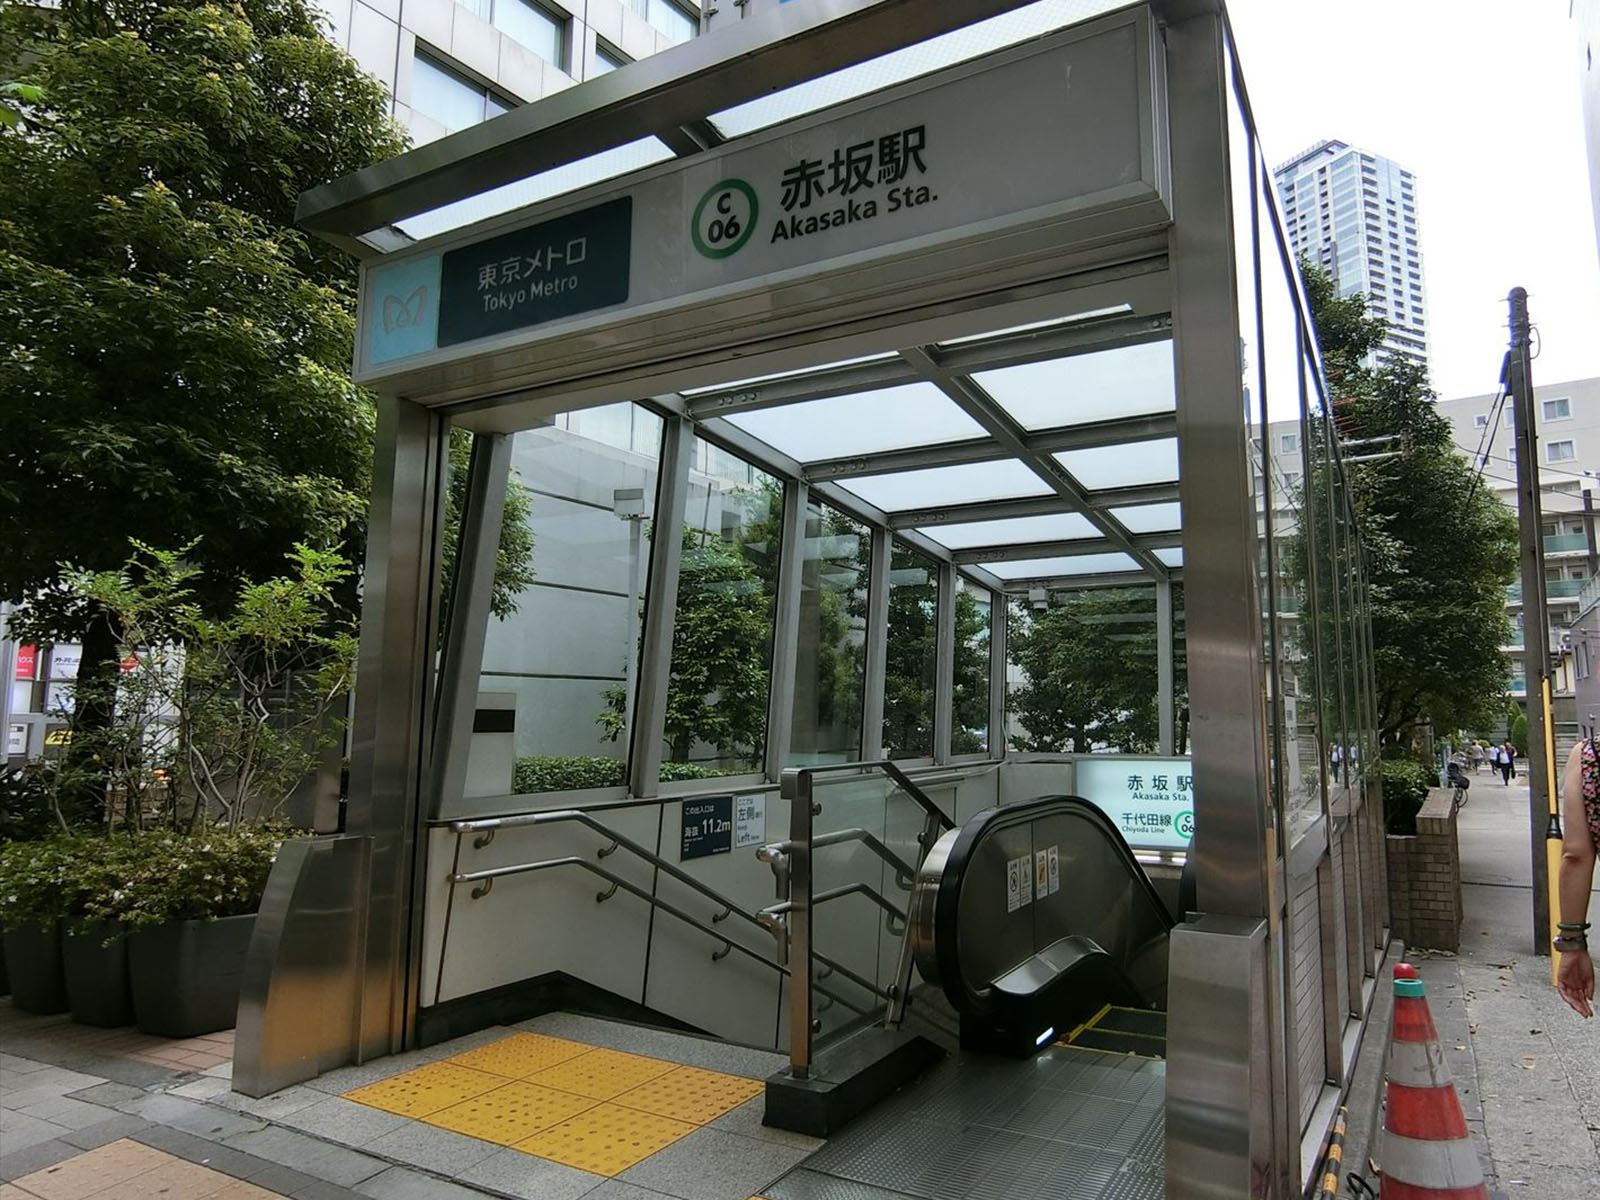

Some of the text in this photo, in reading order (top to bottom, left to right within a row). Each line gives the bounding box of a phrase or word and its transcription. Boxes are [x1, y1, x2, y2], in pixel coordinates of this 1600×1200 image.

[780, 125, 927, 212] 赤坂駅
[717, 192, 732, 214] C
[771, 185, 938, 244] Akasaka Sta.
[707, 215, 741, 243] 06
[477, 237, 587, 291] 東京メトロ
[483, 275, 579, 312] Tokyo Metro
[1127, 775, 1194, 792] 赤坂駅
[1132, 792, 1190, 801] Akasaka Sta.
[703, 819, 731, 835] 11.2m
[1121, 812, 1172, 826] 千代田線
